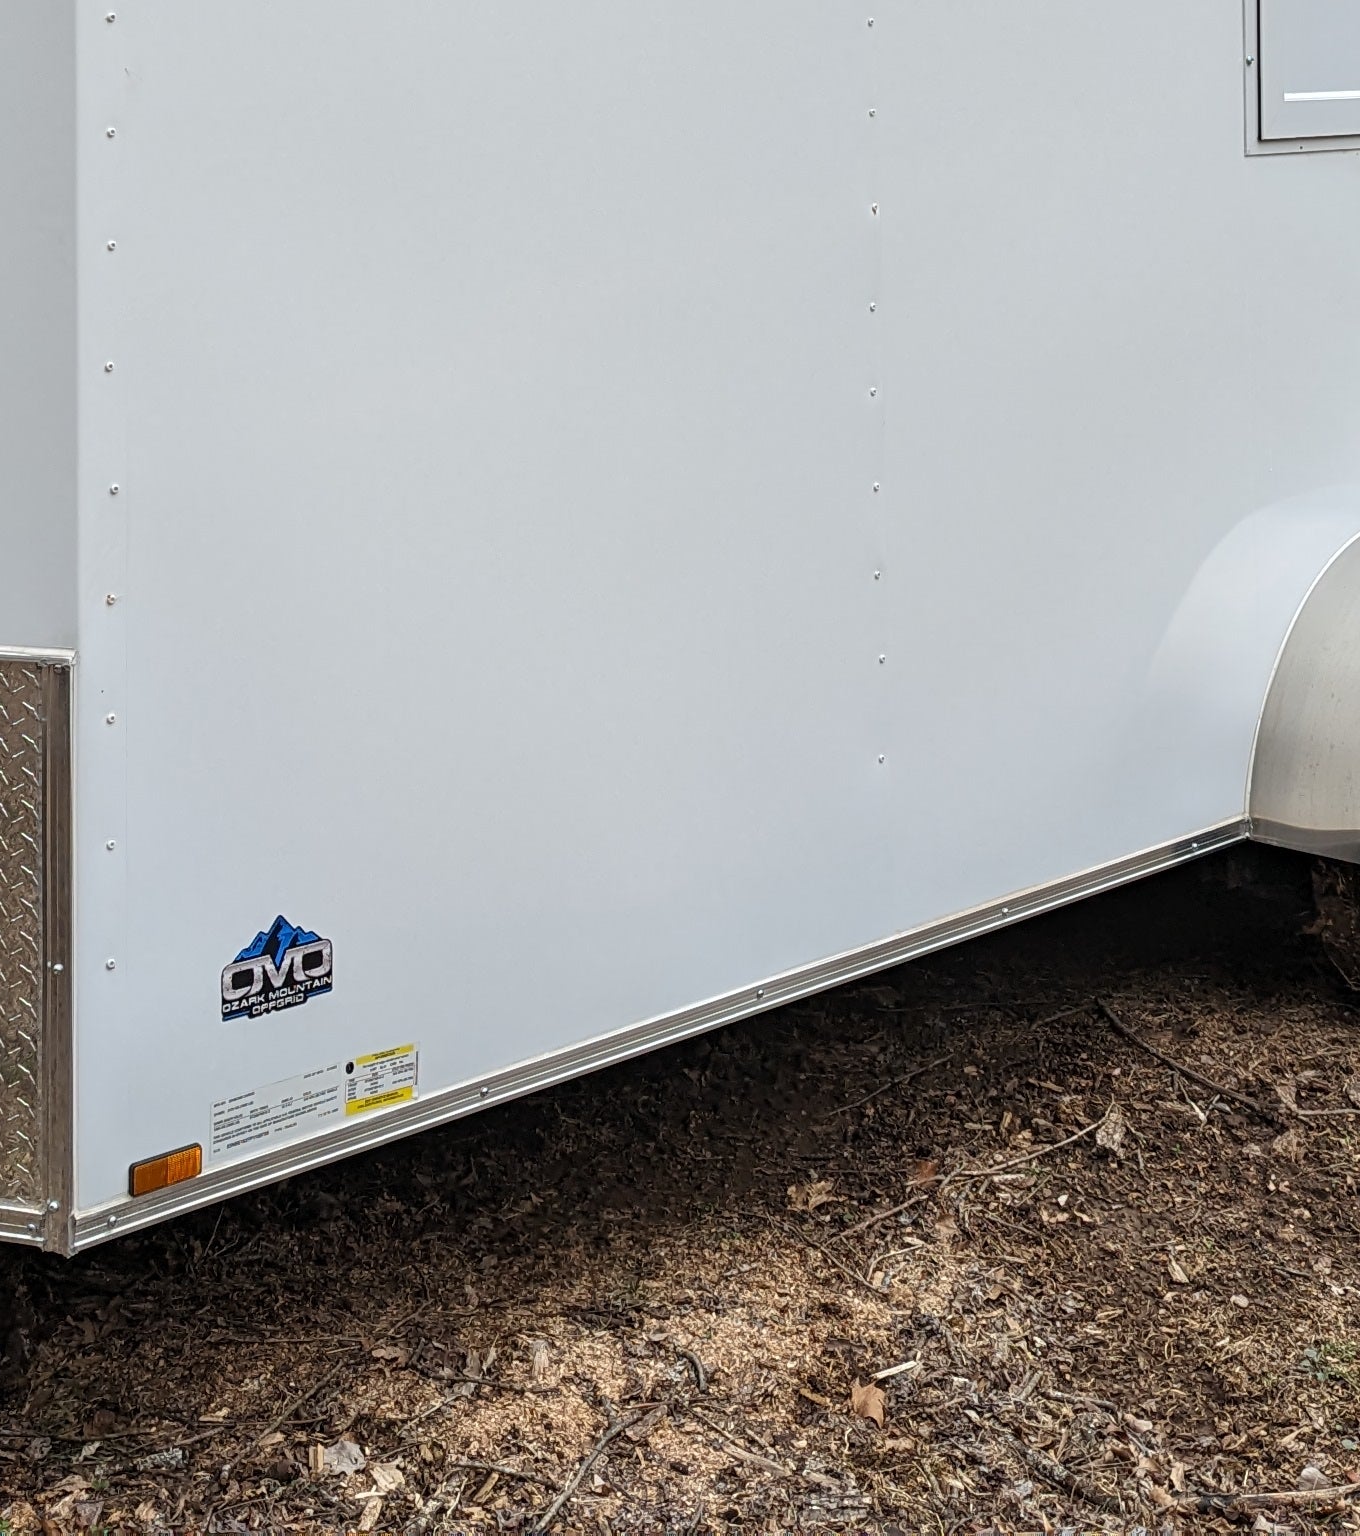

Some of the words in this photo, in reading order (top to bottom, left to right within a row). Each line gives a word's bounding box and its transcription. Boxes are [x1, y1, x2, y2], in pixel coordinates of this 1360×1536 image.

[222, 993, 266, 1013] OZARK
[268, 975, 332, 1001] MOUNTAIN
[252, 994, 304, 1015] OFFGRID
